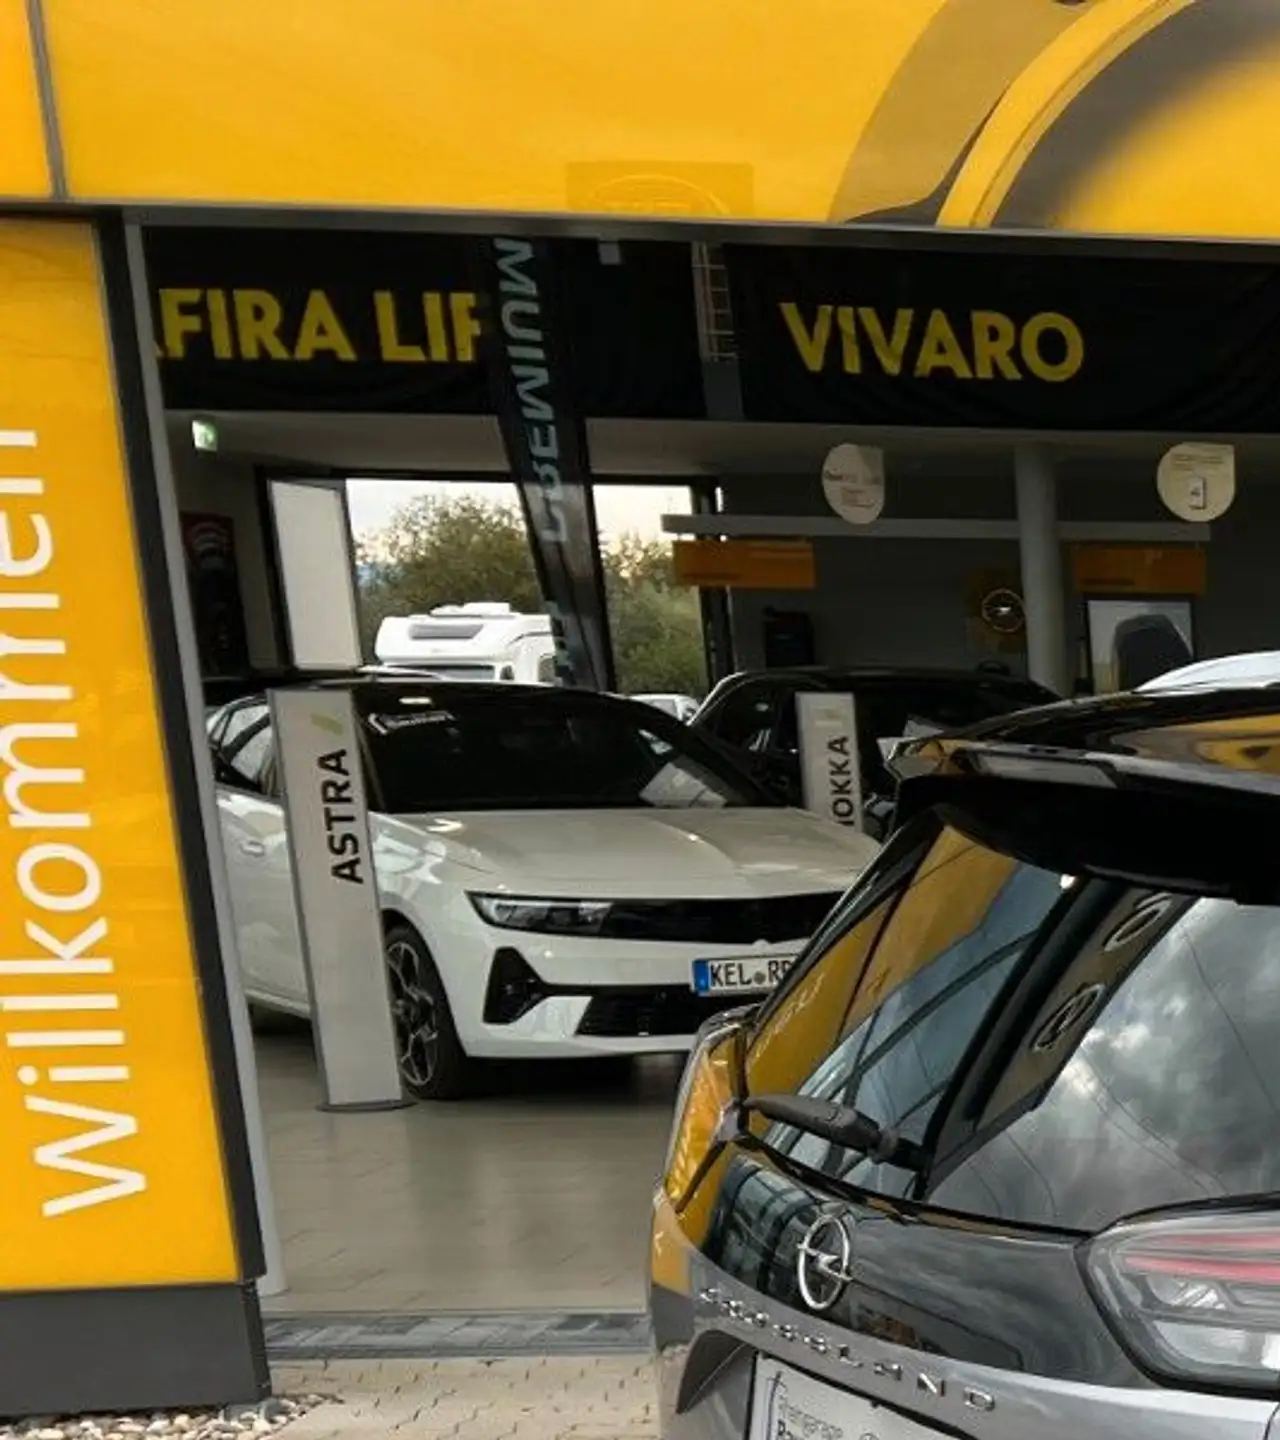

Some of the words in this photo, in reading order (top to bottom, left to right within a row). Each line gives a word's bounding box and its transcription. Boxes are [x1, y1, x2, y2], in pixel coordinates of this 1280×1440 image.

[153, 288, 358, 361] FIRA
[780, 302, 1084, 383] VIVARO
[317, 749, 364, 884] ASTRA
[709, 963, 752, 987] KEL
